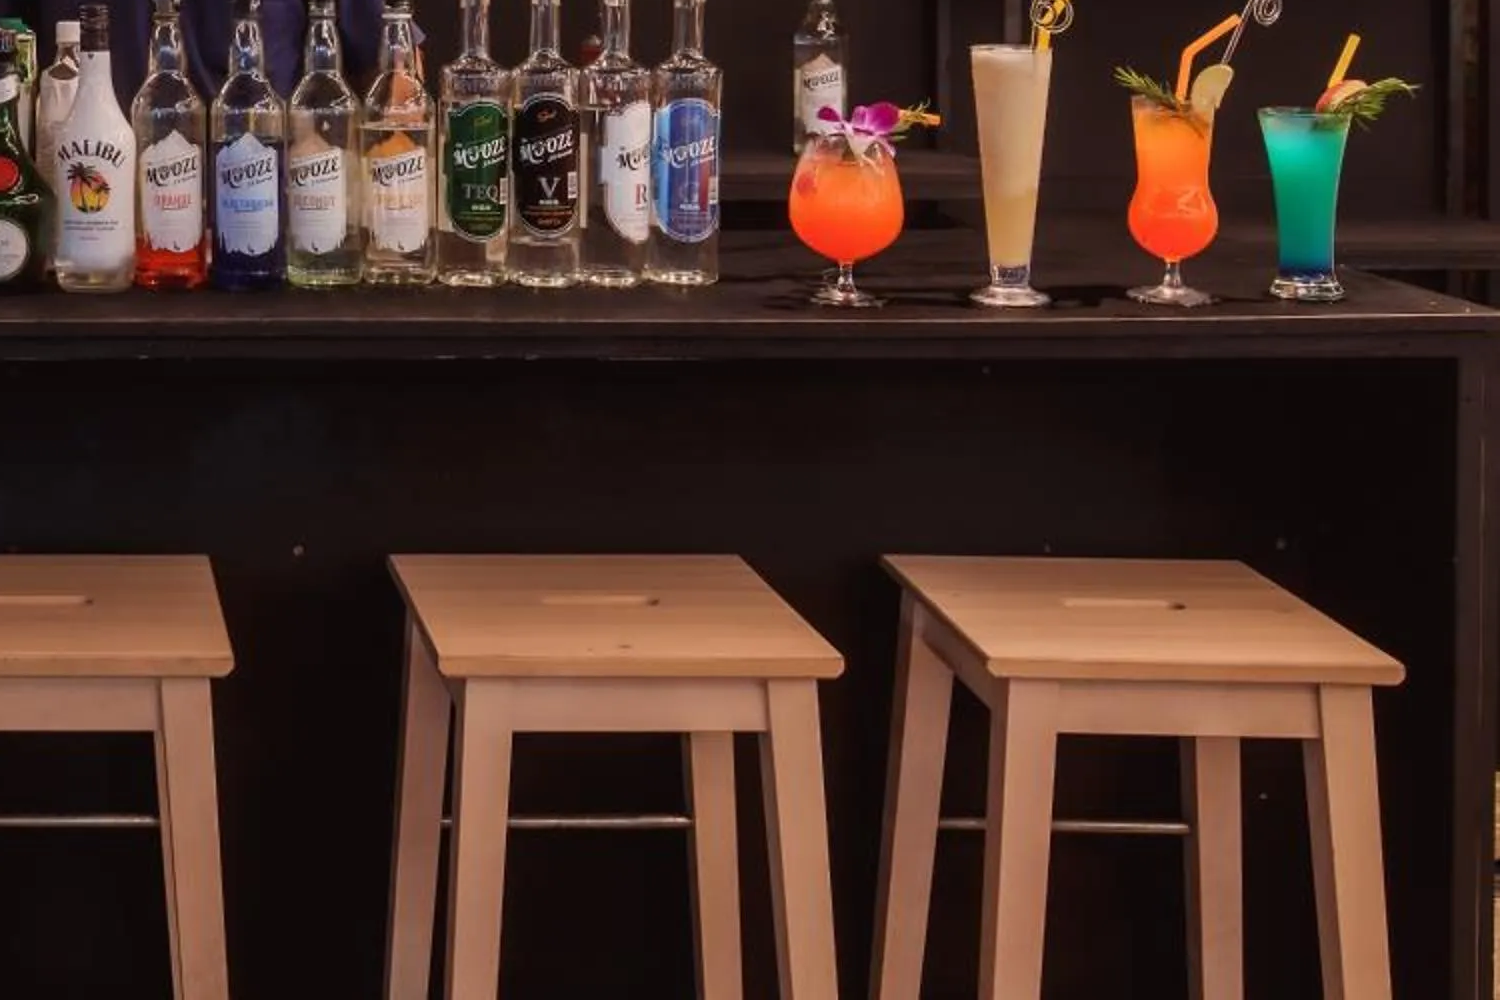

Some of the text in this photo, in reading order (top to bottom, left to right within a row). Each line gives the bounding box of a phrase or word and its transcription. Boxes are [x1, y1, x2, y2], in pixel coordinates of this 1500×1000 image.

[57, 138, 126, 169] MALIBU
[453, 136, 506, 169] MOOZE
[519, 129, 573, 165] MOOZE
[662, 136, 715, 169] MOOZE
[146, 156, 197, 187] MOOZE
[222, 158, 273, 189] MOOZE
[288, 156, 339, 187] MOOZE
[371, 155, 423, 187] MOOZE
[539, 177, 561, 199] V
